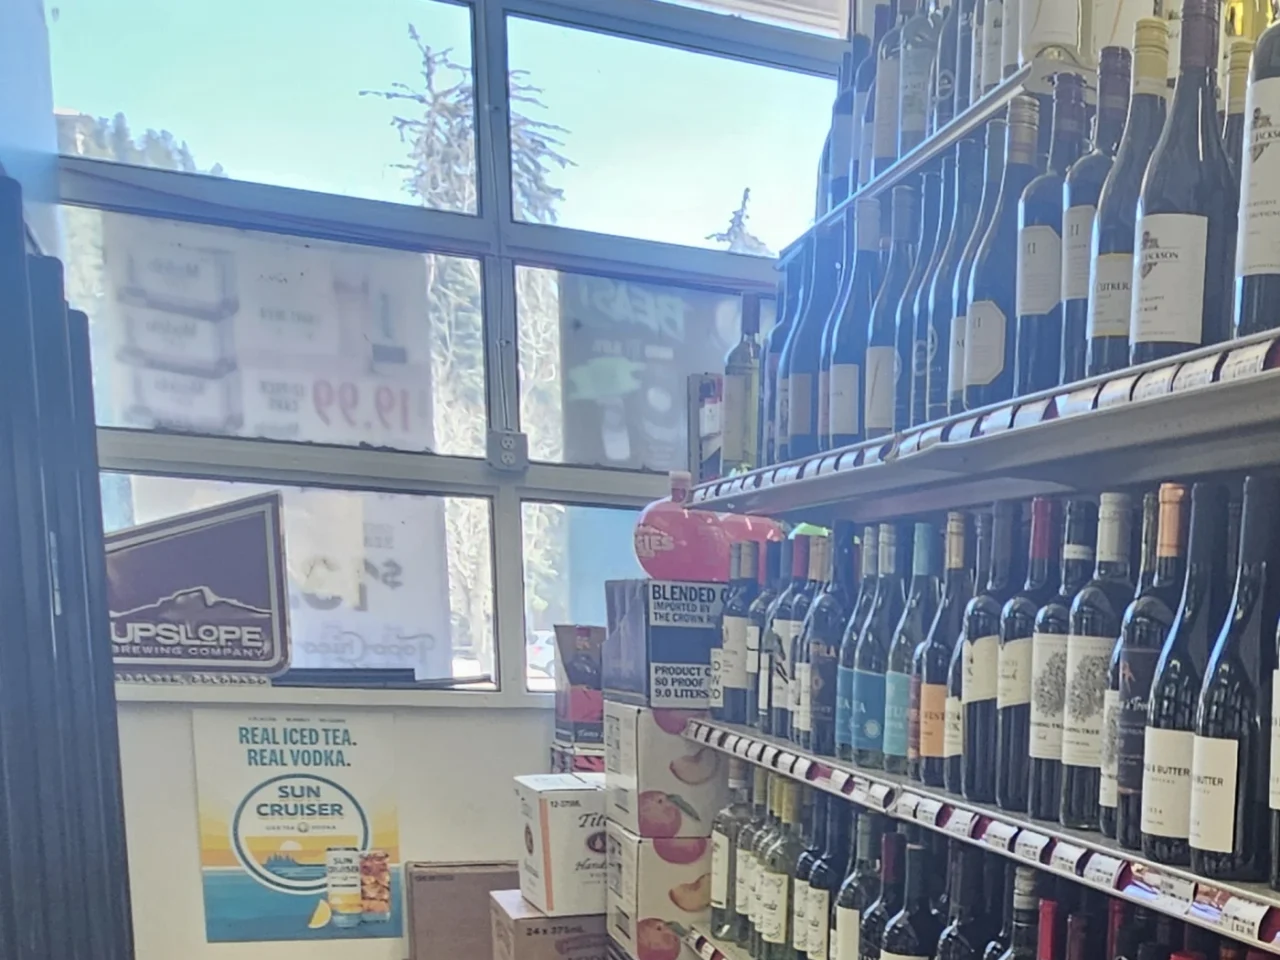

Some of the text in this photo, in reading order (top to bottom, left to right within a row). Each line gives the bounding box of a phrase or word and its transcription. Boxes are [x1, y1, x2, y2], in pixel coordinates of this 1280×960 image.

[652, 585, 716, 603] BLENDED
[654, 603, 697, 613] IMPORTED
[654, 612, 670, 622] THE
[111, 623, 263, 646] UPSLOPE
[188, 648, 263, 657] COMPANY
[655, 666, 700, 676] PRODUCT
[655, 678, 704, 687] 80 PROOF
[655, 689, 671, 698] 9.0
[239, 726, 357, 746] REAL ICED TEA.
[247, 749, 351, 767] REAL VODKA.
[1156, 765, 1191, 777] BUTTER
[278, 786, 321, 798] SUN
[256, 804, 344, 816] CRUISER
[526, 927, 541, 936] 24
